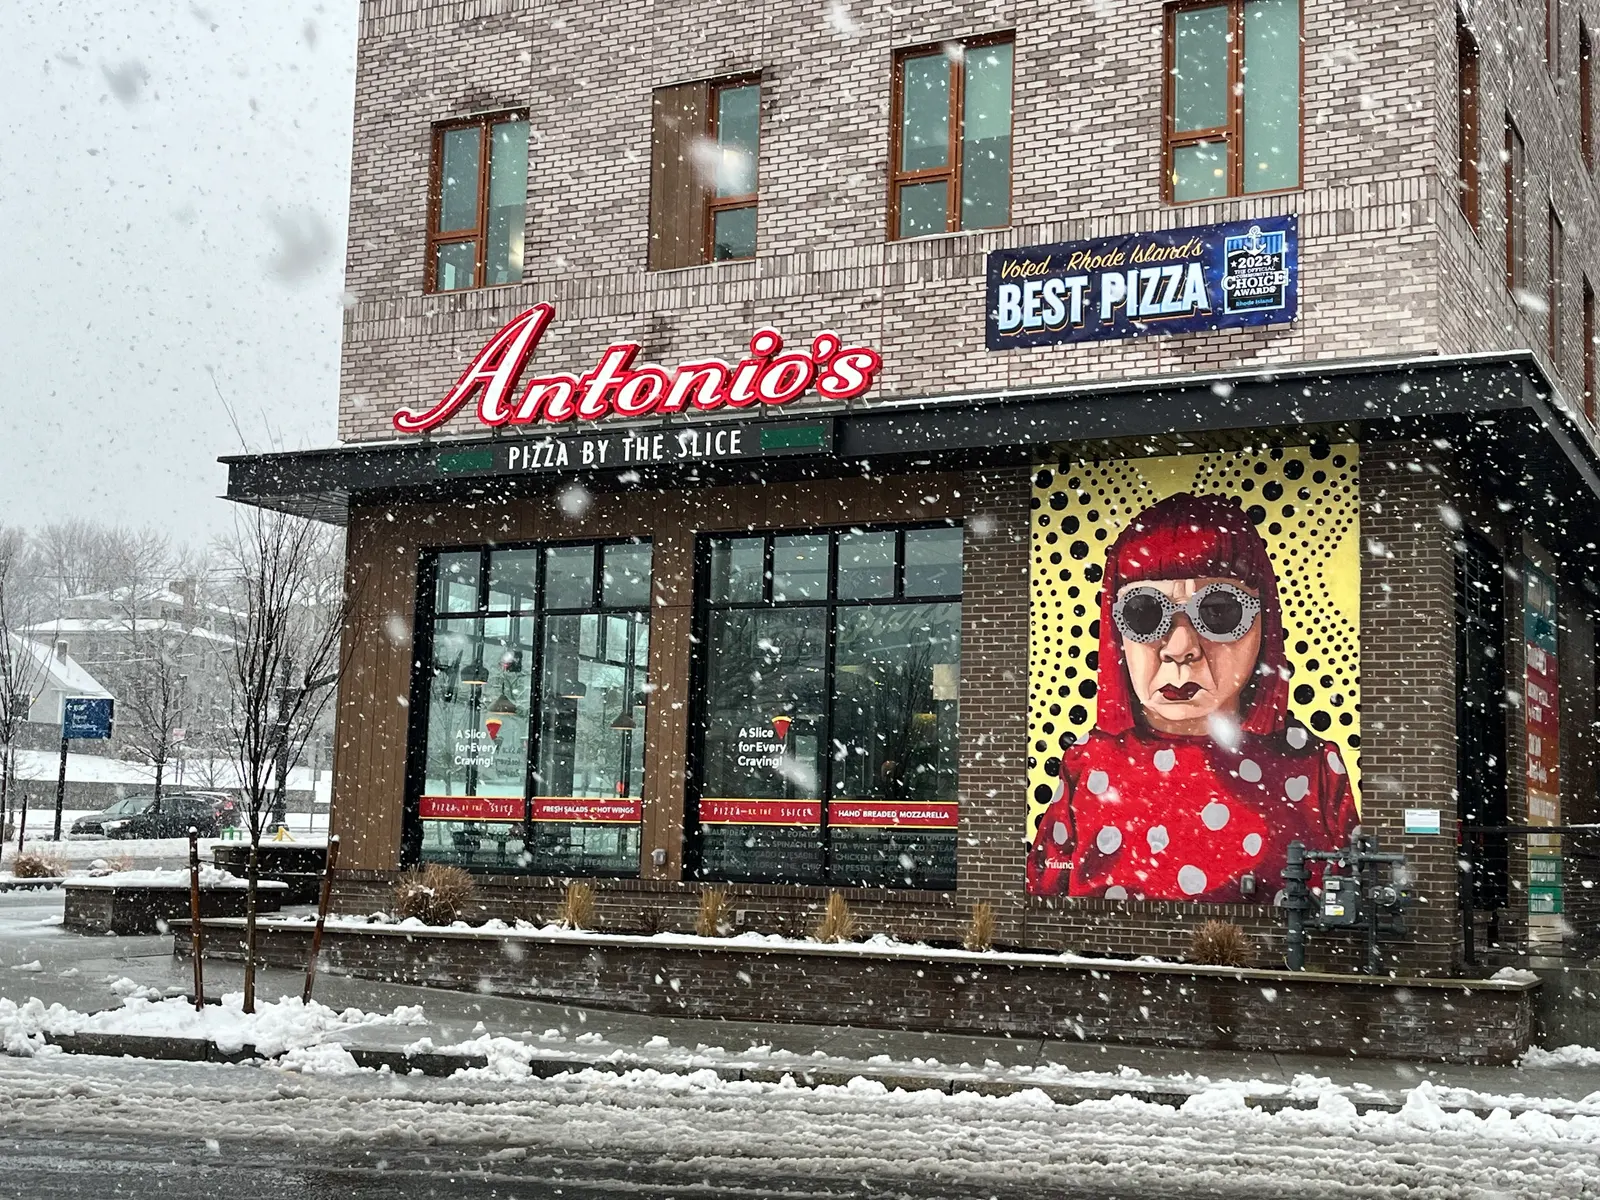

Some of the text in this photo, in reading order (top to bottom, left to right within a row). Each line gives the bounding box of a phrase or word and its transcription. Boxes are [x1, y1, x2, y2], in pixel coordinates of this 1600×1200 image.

[1001, 237, 1204, 279] Voted Rhode Island's
[1237, 255, 1272, 268] 2023
[1222, 270, 1288, 290] CHOICE
[1233, 285, 1277, 297] AWARDS
[998, 263, 1210, 332] BEST PIZZA
[1255, 297, 1274, 305] Island
[394, 302, 883, 431] Antonio's
[508, 430, 741, 470] PIZZA BY THE SLICE
[456, 729, 487, 738] A Slice
[738, 727, 774, 738] A Slice
[455, 742, 498, 754] for Every
[738, 741, 786, 754] for Every
[454, 756, 494, 768] Craving!
[738, 755, 782, 769] Craving!
[713, 806, 740, 815] PIZZA
[781, 808, 807, 817] SLICE
[862, 810, 897, 818] BREADED
[899, 811, 949, 819] MOZZARELLA
[836, 853, 871, 861] CHICKEN
